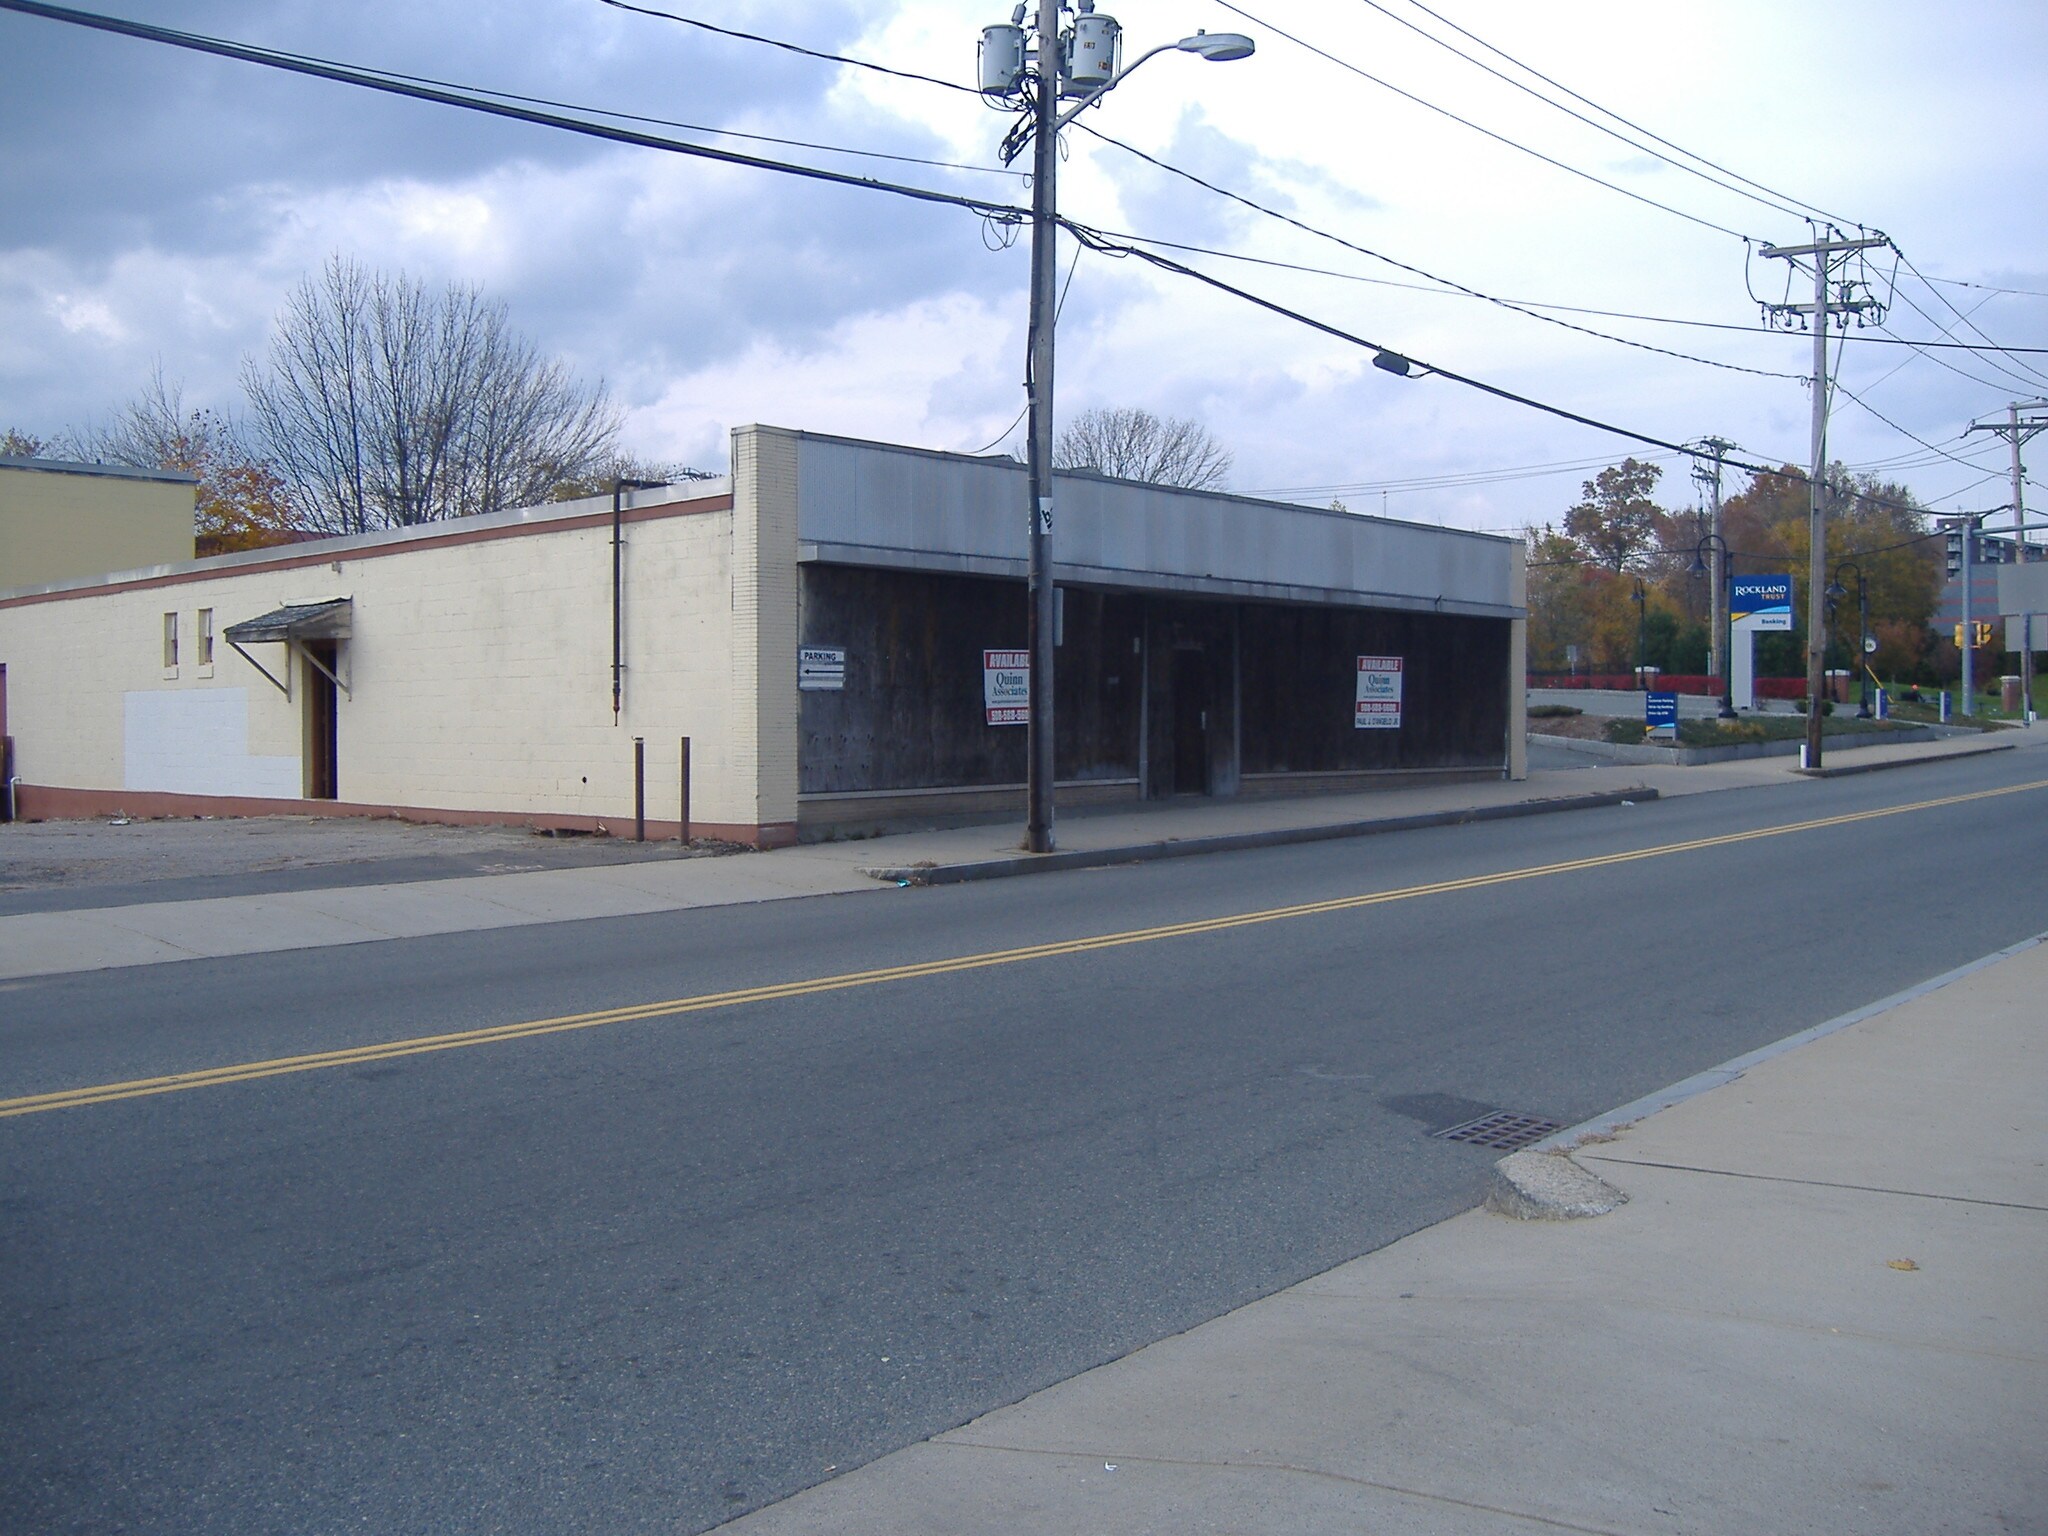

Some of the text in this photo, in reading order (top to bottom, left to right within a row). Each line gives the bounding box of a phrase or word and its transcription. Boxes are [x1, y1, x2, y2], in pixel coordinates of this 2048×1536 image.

[1735, 585, 1787, 596] ROCKLAND
[804, 652, 836, 661] PARKING
[989, 653, 1030, 668] AVAILABL
[1361, 659, 1398, 671] AVAILABLE
[996, 672, 1023, 688] Quinn
[1368, 674, 1390, 686] Quinn
[992, 686, 1028, 696] Associates
